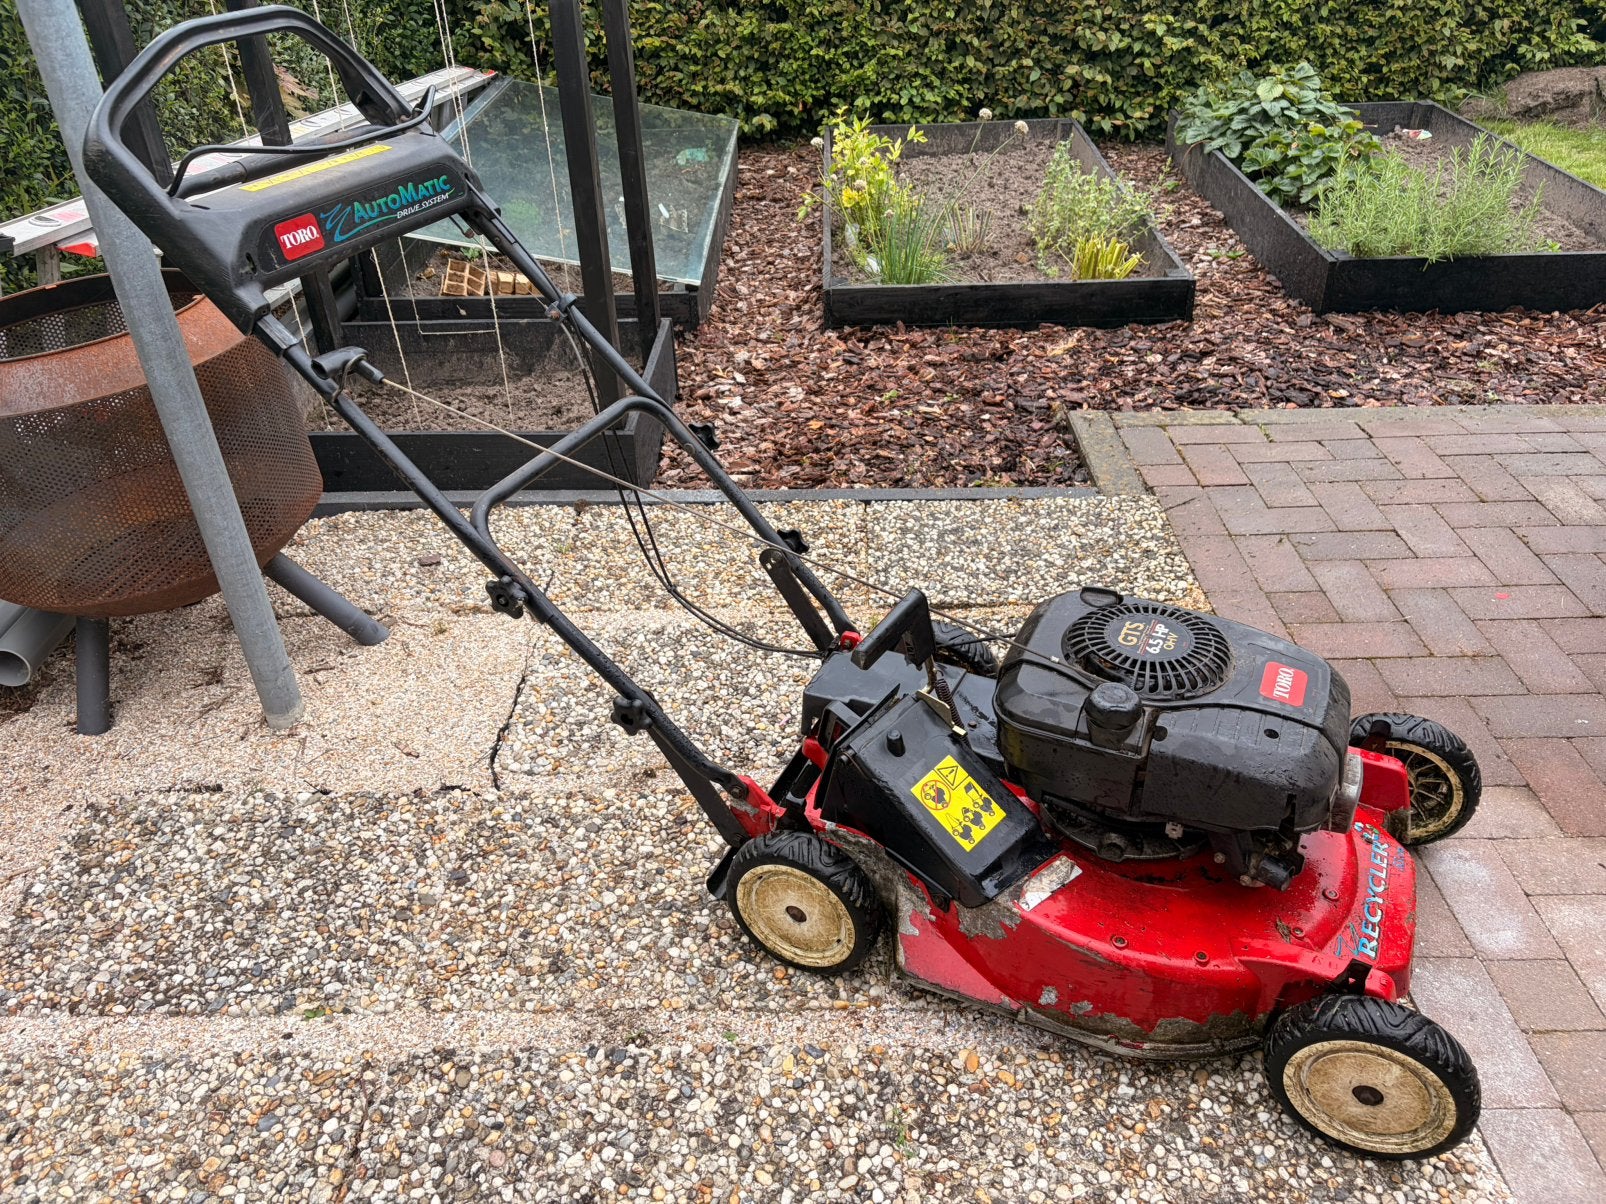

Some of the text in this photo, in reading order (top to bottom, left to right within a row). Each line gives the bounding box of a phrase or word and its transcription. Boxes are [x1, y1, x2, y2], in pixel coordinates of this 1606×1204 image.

[396, 193, 449, 219] DRIVE SYSTEM
[280, 225, 319, 249] TORO
[1118, 621, 1145, 646] GTS
[1152, 623, 1169, 638] HP
[1163, 632, 1179, 650] OHV
[1146, 638, 1164, 654] 6.5
[1273, 667, 1294, 699] TORO
[1358, 840, 1389, 960] RECYCLER
